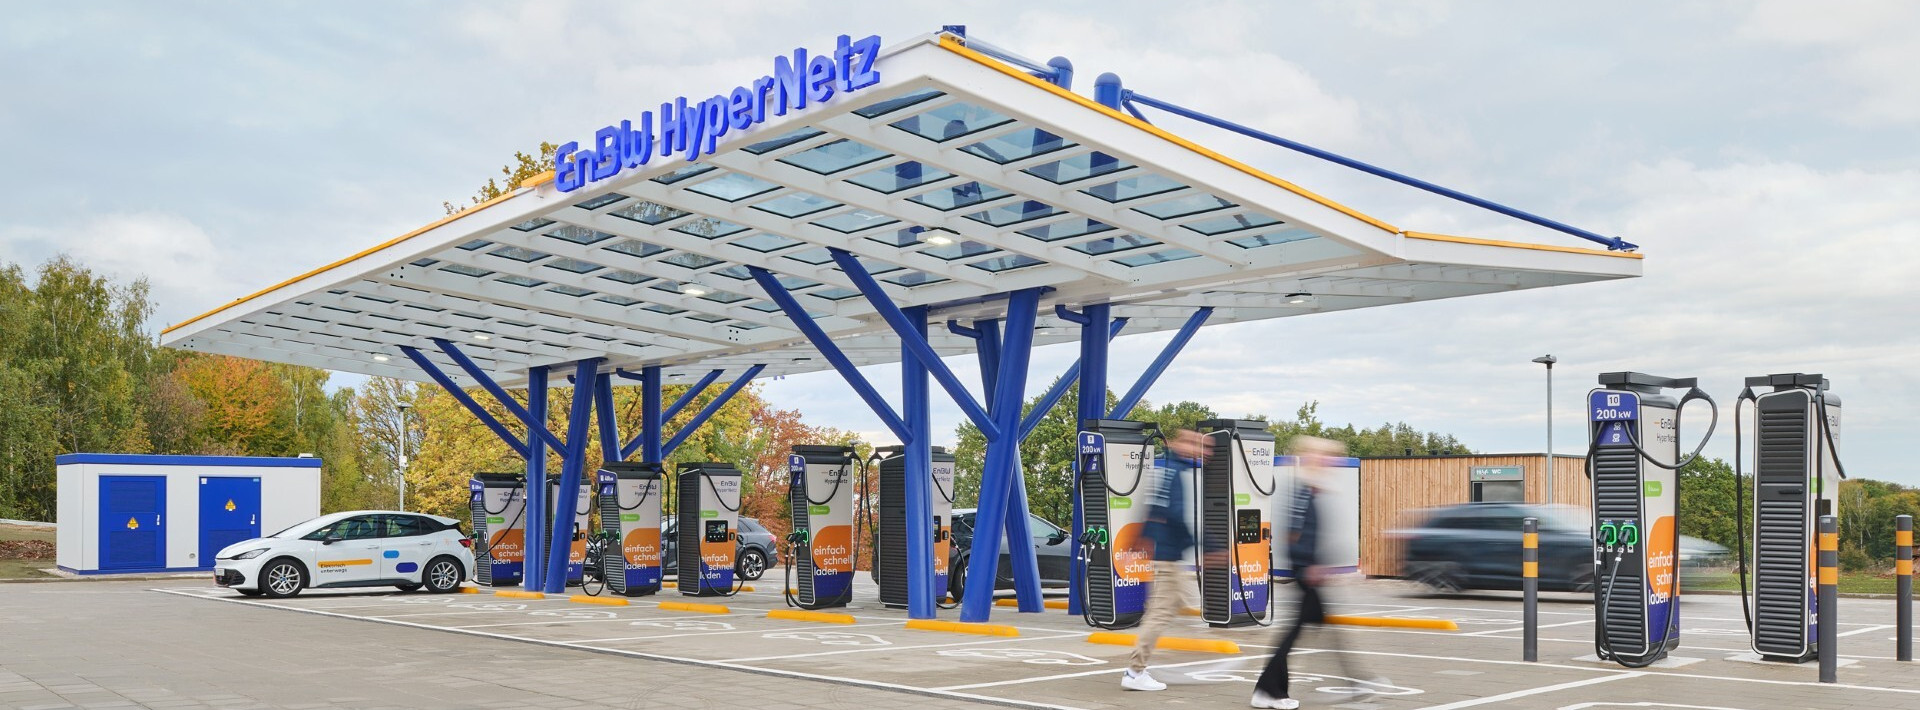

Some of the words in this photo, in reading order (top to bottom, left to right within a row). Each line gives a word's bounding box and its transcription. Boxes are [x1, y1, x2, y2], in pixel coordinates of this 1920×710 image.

[554, 111, 653, 192] EnBW
[660, 34, 881, 162] HyperNetz
[1609, 396, 1619, 405] 10
[1596, 408, 1617, 420] 200
[1618, 411, 1632, 419] kW
[1660, 418, 1676, 429] EnBW
[1082, 446, 1093, 454] 200
[1252, 447, 1270, 457] EnBW
[932, 467, 951, 475] EnBW
[814, 545, 846, 556] einfach
[1114, 548, 1148, 561] einfach
[490, 557, 511, 565] laden
[633, 553, 660, 561] schnell
[701, 554, 728, 562] einfach
[823, 555, 853, 566] schnell
[624, 561, 647, 570] laden
[708, 562, 734, 570] schnell
[1231, 560, 1262, 575] enfach
[813, 566, 838, 576] laden
[1114, 575, 1140, 588] laden
[1241, 572, 1268, 587] schnell
[1648, 588, 1669, 606] laden
